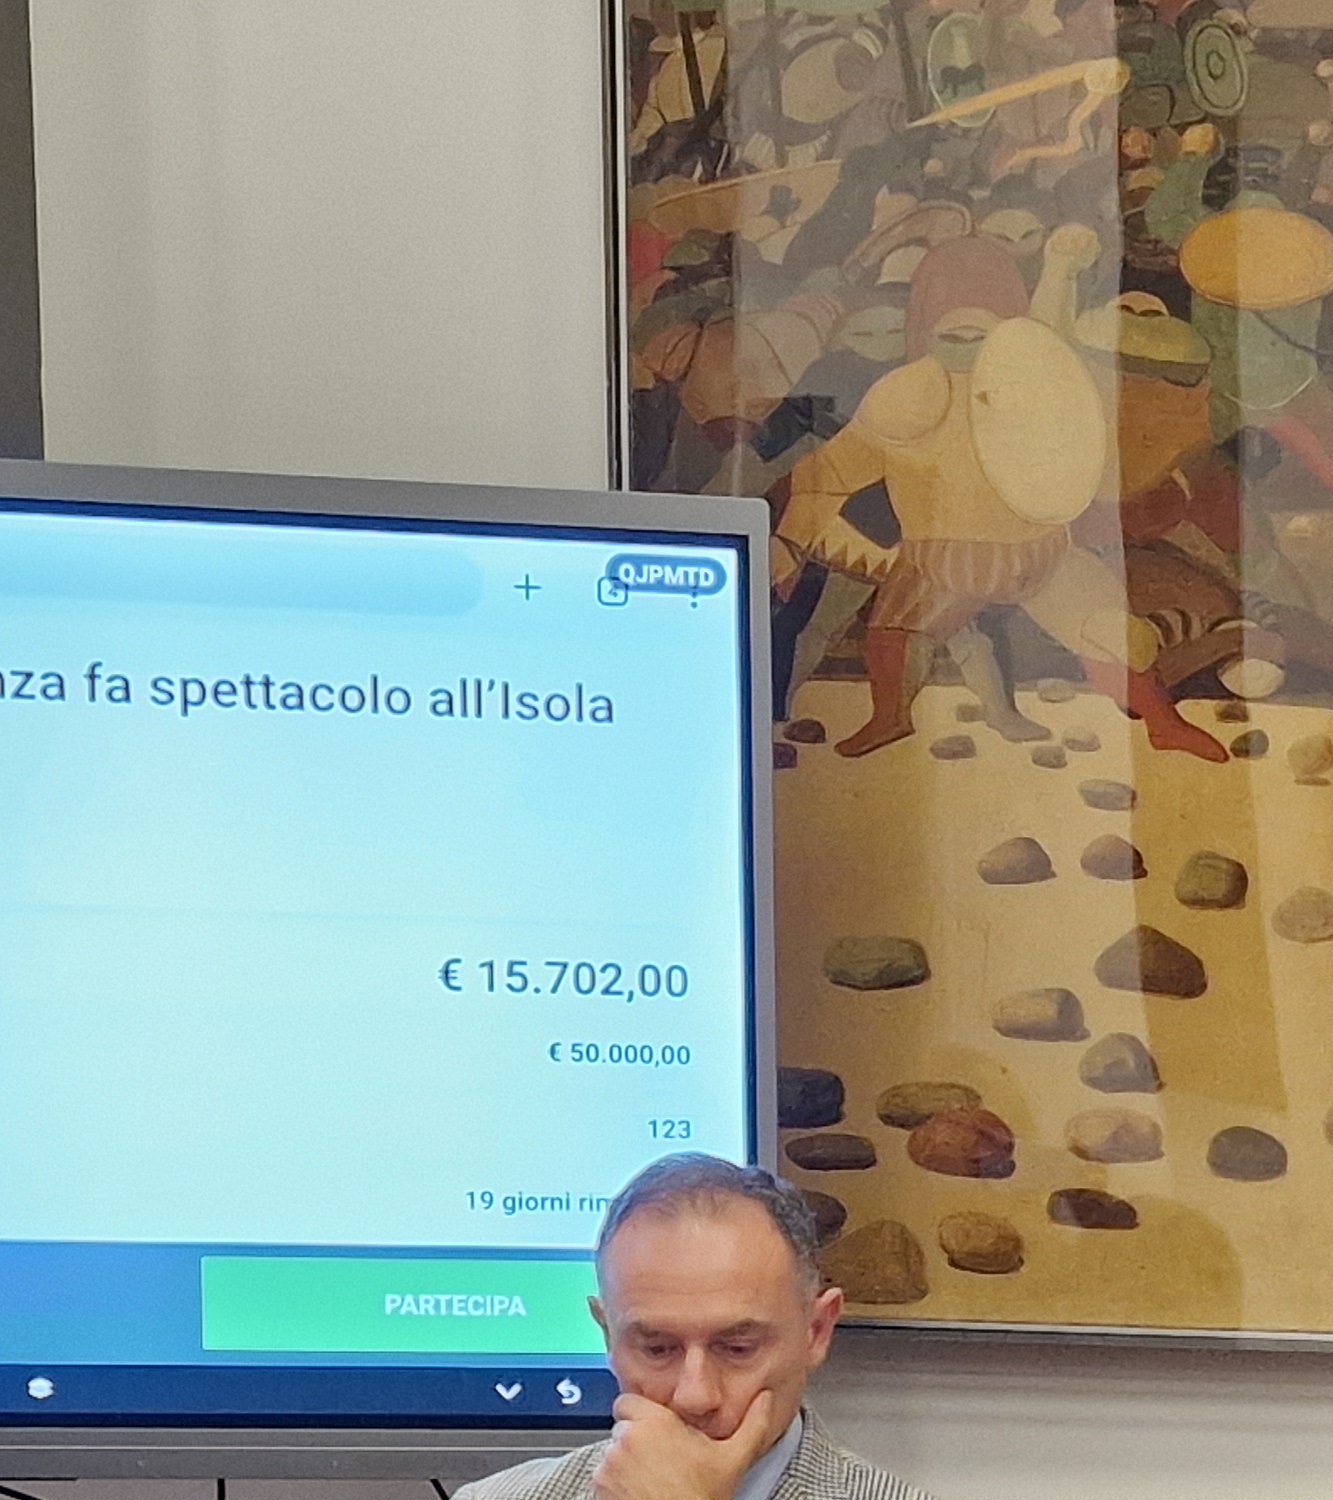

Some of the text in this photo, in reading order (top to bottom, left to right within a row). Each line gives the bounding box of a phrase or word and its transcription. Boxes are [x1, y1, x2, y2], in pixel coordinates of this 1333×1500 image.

[618, 563, 716, 587] QJPMTD
[0, 661, 615, 725] za fa spettacolo all’Isola
[438, 957, 689, 1004] € 15.702,00
[549, 1041, 691, 1068] € 50.000,00
[647, 1119, 691, 1140] 123
[466, 1190, 494, 1210] 19
[502, 1190, 571, 1216] giorni
[384, 1293, 528, 1318] PARTECIPA
